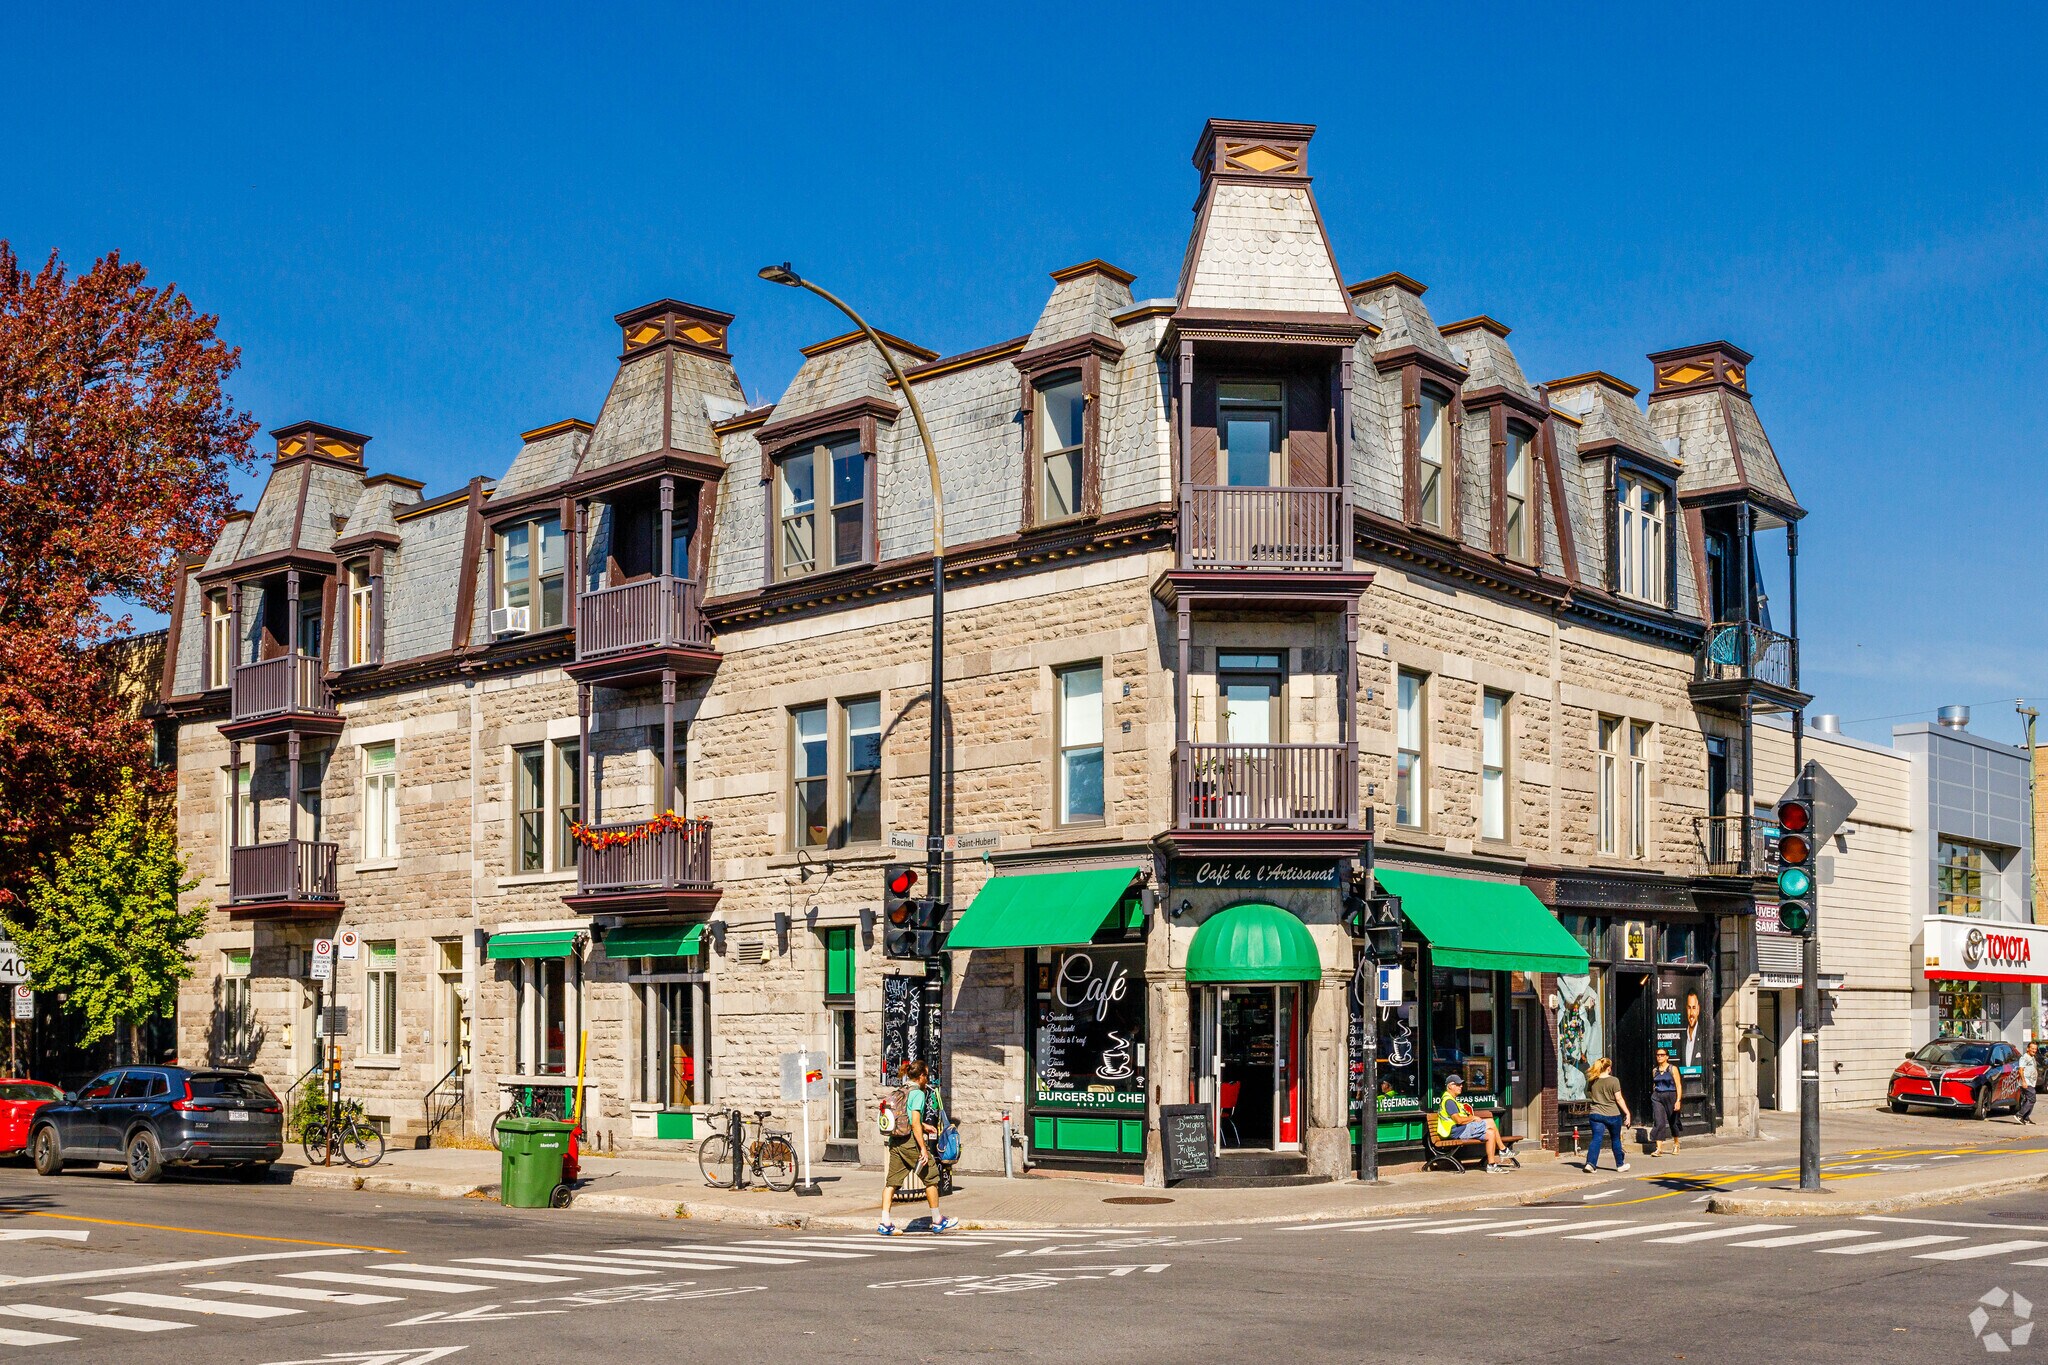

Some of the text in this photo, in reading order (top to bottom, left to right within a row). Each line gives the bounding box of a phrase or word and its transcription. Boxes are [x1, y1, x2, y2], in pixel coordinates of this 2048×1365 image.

[891, 837, 914, 848] Rachel
[957, 837, 997, 849] Saint-Hubert
[1196, 862, 1334, 886] Café de l'Artisanat
[1755, 920, 1780, 933] SAME
[1986, 933, 2031, 962] TOYOTA
[1, 958, 28, 977] 40
[1056, 953, 1128, 1022] Café
[1660, 1013, 1681, 1025] VENDRE
[1047, 1068, 1070, 1080] Burgers
[1038, 1092, 1095, 1102] BURGERS
[1097, 1093, 1114, 1103] DU
